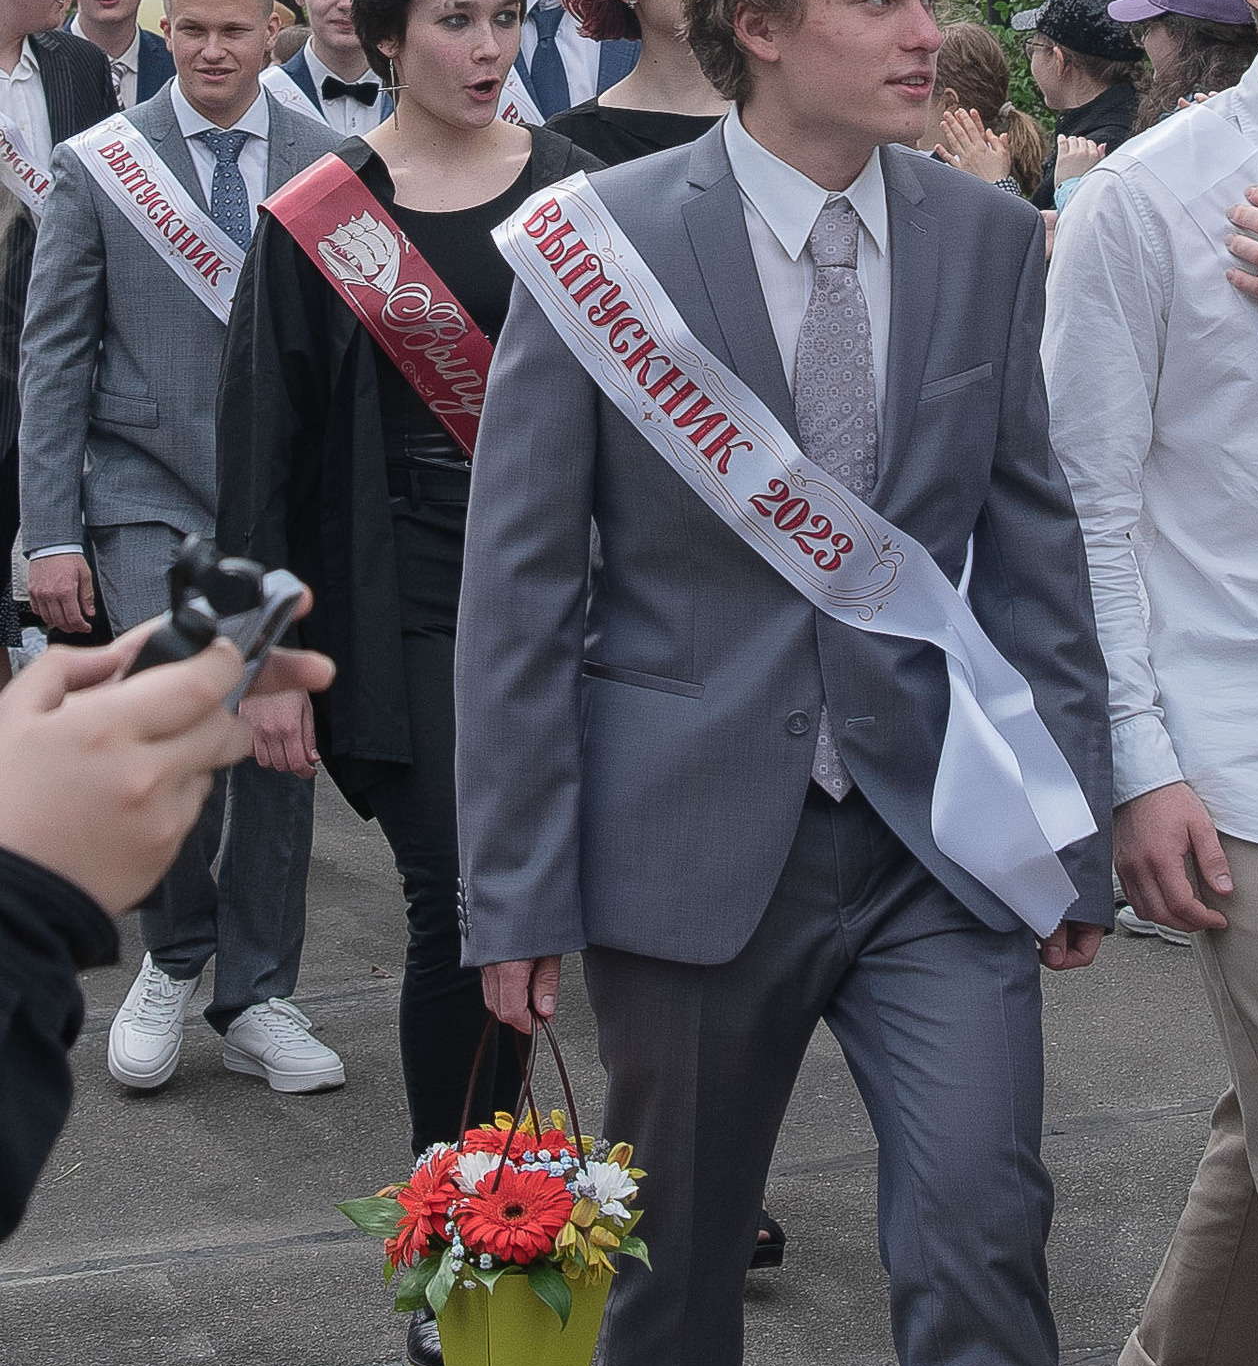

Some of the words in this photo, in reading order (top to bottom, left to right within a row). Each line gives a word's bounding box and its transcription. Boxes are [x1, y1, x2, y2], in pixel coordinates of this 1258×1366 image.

[97, 139, 232, 287] ВЫПУСКНИК
[522, 197, 755, 475] ВЫПУСКНИК
[747, 477, 855, 572] 2023
